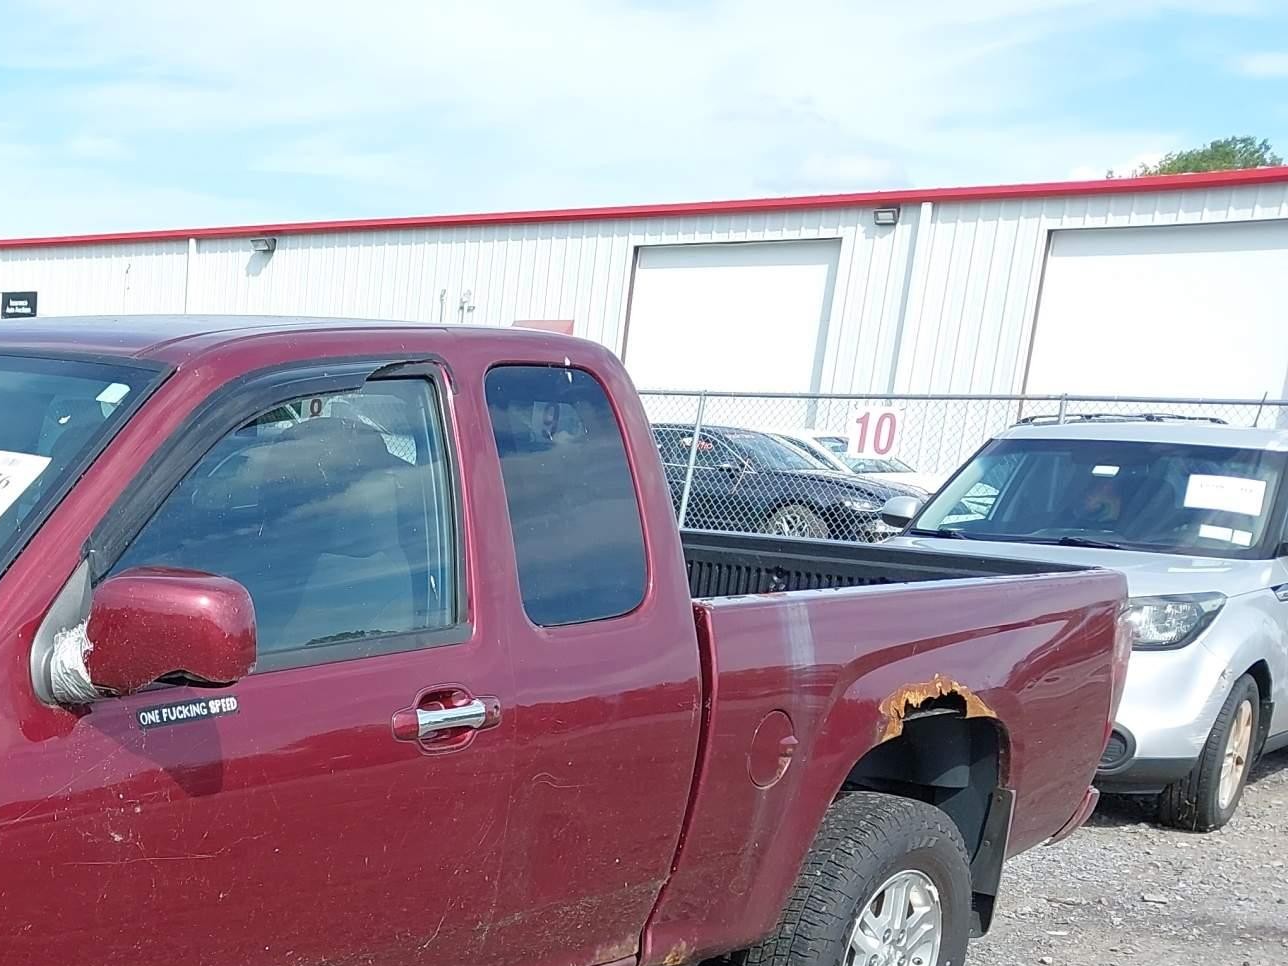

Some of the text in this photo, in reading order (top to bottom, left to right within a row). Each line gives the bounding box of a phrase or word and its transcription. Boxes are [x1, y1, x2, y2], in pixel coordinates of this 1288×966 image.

[855, 411, 897, 455] 10
[139, 697, 238, 725] ONE FUCKING SPEED
